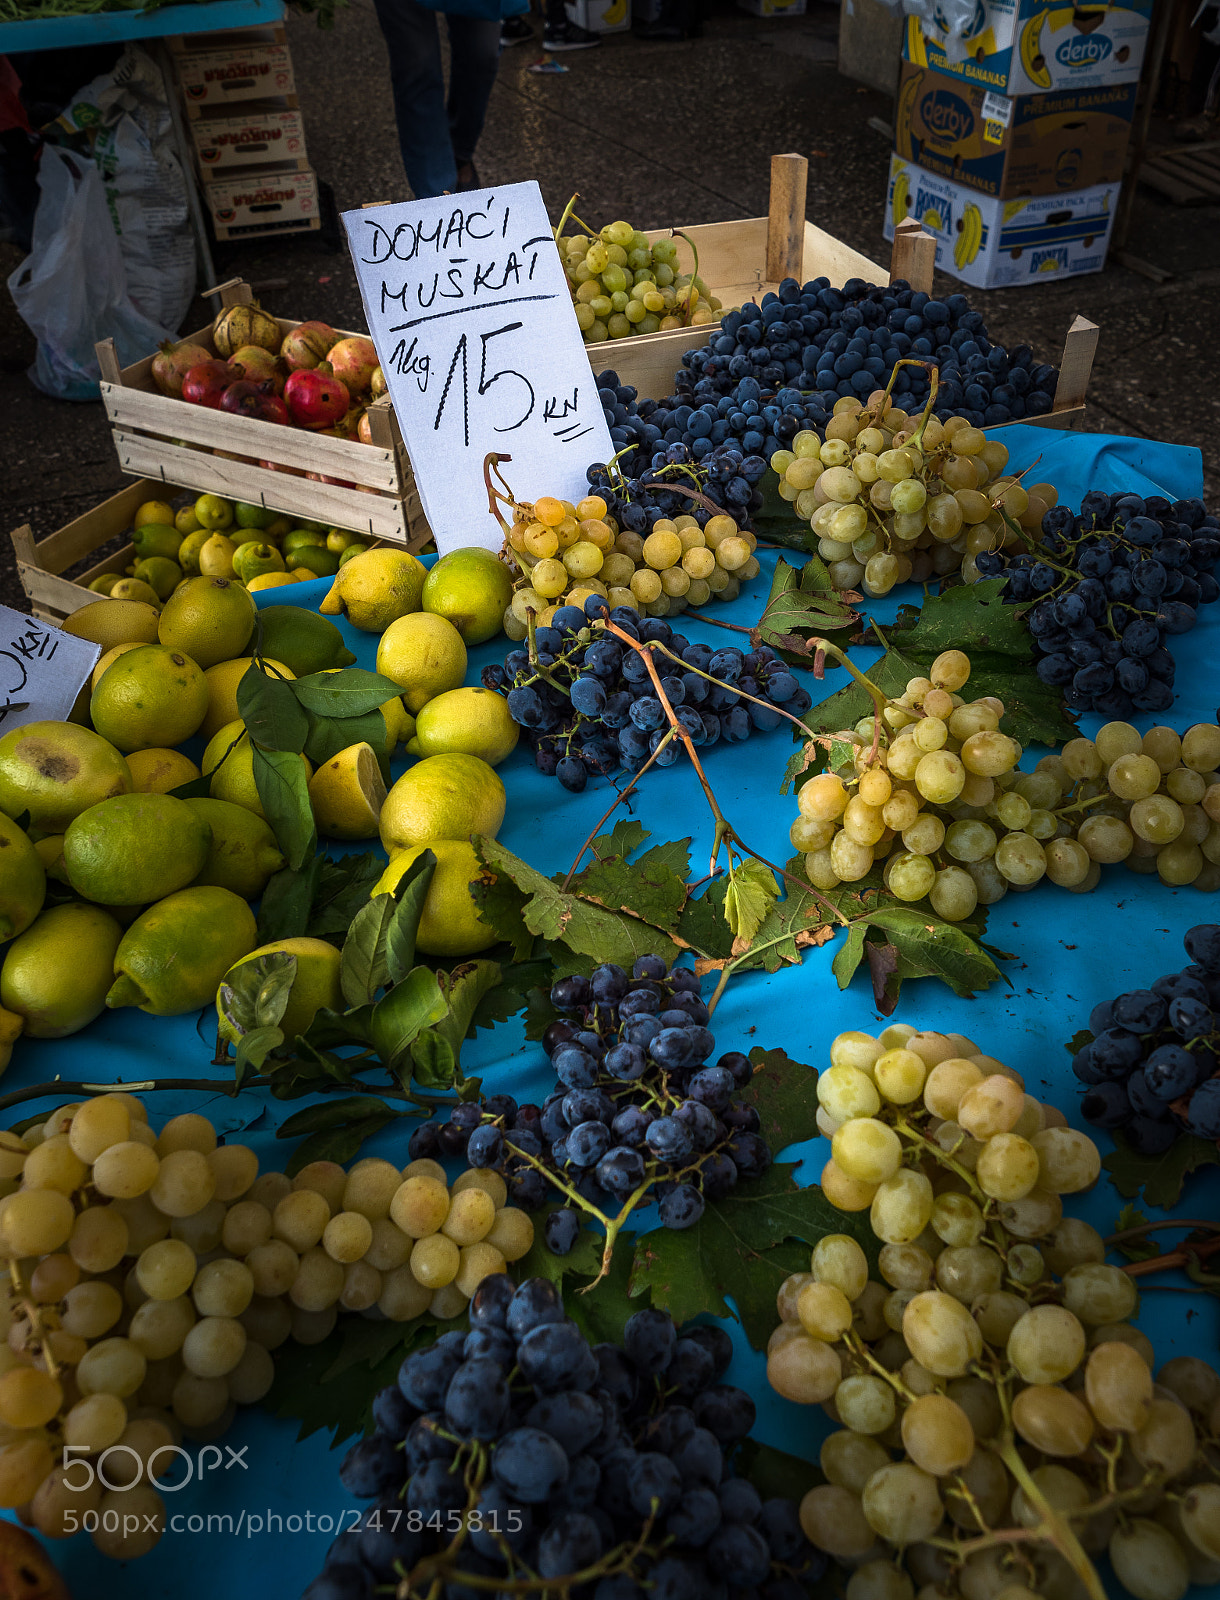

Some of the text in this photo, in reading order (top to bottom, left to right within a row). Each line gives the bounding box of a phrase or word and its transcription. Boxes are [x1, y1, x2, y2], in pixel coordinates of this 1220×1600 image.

[1060, 38, 1110, 60] derby
[204, 62, 270, 82] AURORA
[965, 64, 1007, 88] BANANAS
[923, 90, 972, 140] derby
[1023, 98, 1076, 116] PREMIUM
[1079, 89, 1129, 108] BANANAS
[218, 128, 282, 145] AURORA
[953, 167, 997, 193] BANANAS
[233, 189, 296, 206] AURORA
[361, 196, 510, 264] DOMAĆI
[381, 236, 554, 313] MUŠKAT
[434, 321, 536, 447] 15
